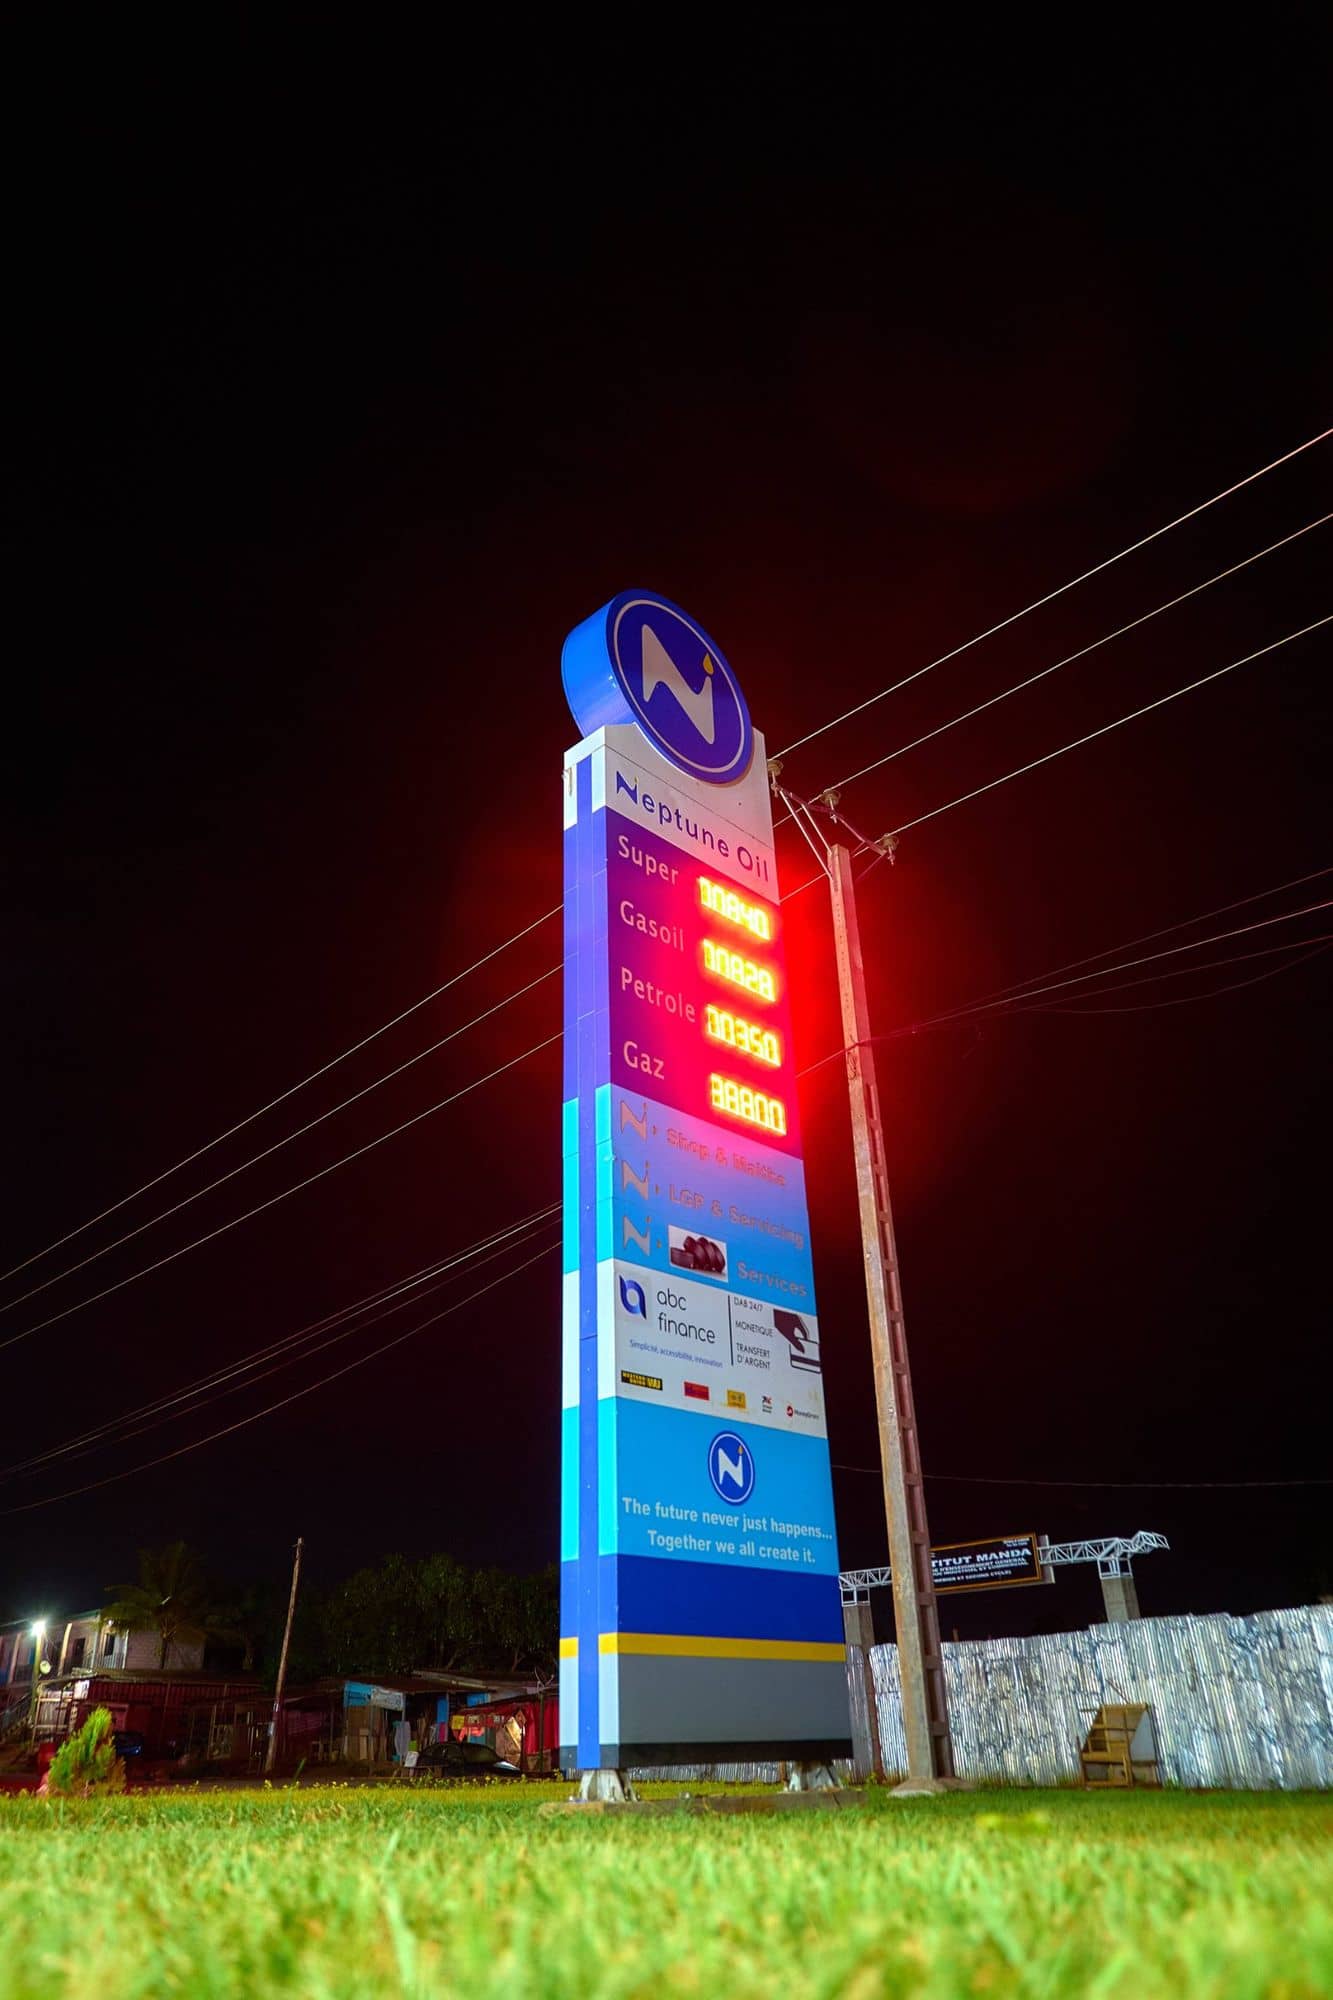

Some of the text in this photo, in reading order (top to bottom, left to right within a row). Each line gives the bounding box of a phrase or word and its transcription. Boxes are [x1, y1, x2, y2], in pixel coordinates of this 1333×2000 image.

[616, 771, 769, 882] Neptune Oil
[618, 835, 680, 886] Super
[620, 900, 684, 951] Gasoil
[621, 967, 696, 1023] Petrole
[623, 1040, 665, 1080] Gaz
[666, 1128, 710, 1160] Shop
[714, 1147, 729, 1167] &
[711, 1200, 723, 1217] &
[729, 1205, 805, 1249] Servicing
[737, 1261, 808, 1297] Services
[656, 1288, 687, 1311] abc
[734, 1297, 763, 1312] DAB 24/7
[658, 1313, 716, 1344] finance
[736, 1342, 771, 1358] TRANSFERT
[737, 1355, 771, 1369] D'ARGENT
[622, 1497, 833, 1540] The future never just happens...
[647, 1530, 816, 1563] Together we all create it.
[976, 1548, 1032, 1562] MANDA
